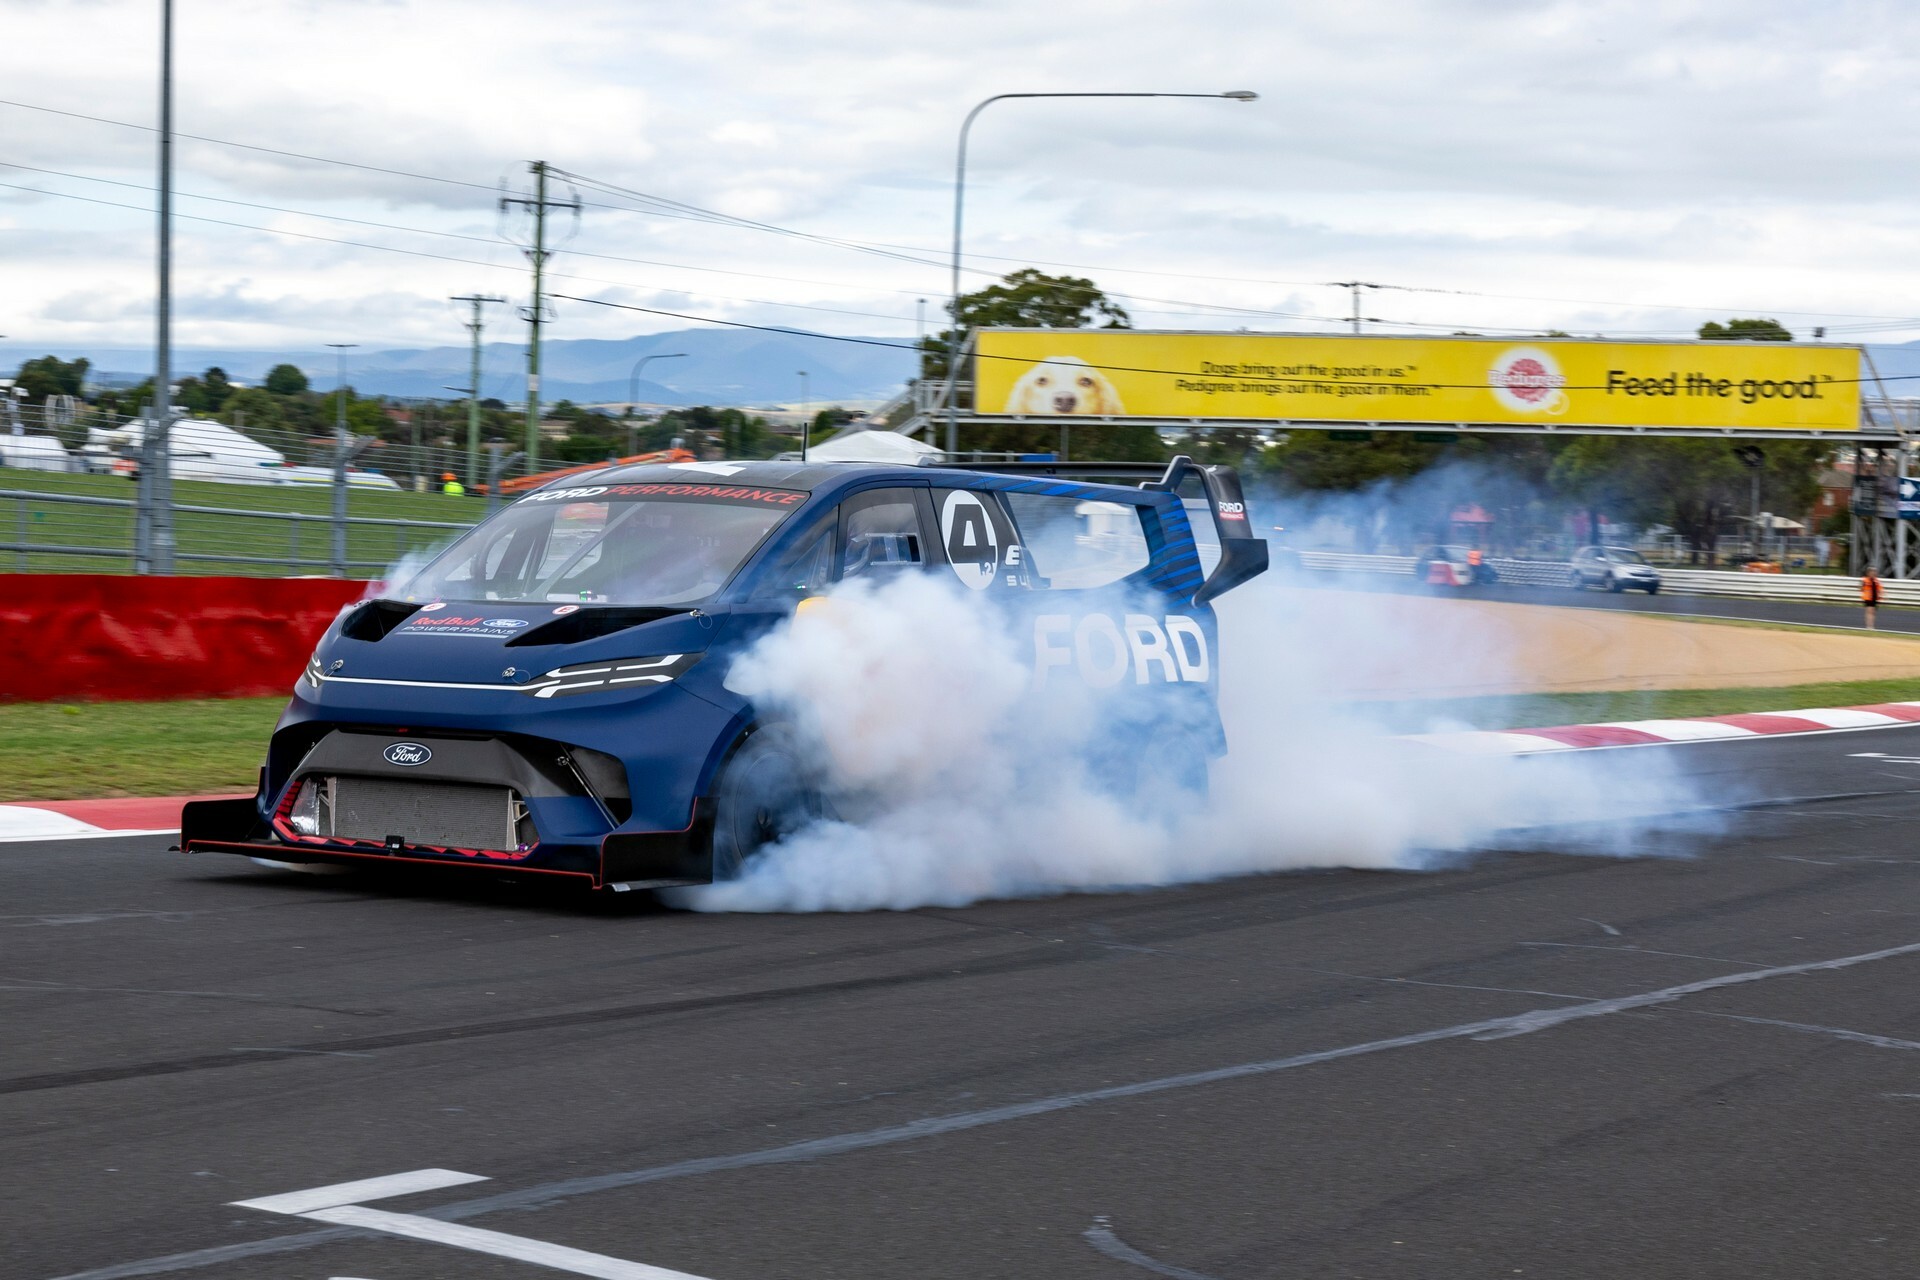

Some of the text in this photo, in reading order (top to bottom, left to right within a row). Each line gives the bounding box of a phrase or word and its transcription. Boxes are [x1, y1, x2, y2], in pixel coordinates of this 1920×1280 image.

[1201, 361, 1238, 378] Dogs
[1240, 362, 1277, 378] bring
[1280, 364, 1302, 375] out
[1306, 364, 1328, 376] the
[1332, 365, 1368, 379] good
[1370, 365, 1383, 376] in
[1176, 379, 1236, 395] Pedigree
[1239, 381, 1282, 396] brings
[1286, 383, 1308, 394] out
[1312, 383, 1334, 394] the
[1337, 384, 1372, 398] good
[1375, 385, 1388, 395] in
[1607, 370, 1677, 396] Feed
[1687, 372, 1731, 397] the
[518, 485, 806, 505] FORD PERFORMANCE
[1219, 501, 1244, 513] FORD
[401, 626, 517, 635] POWERTRAINS
[1034, 612, 1210, 690] FORD
[391, 745, 423, 762] Ford
